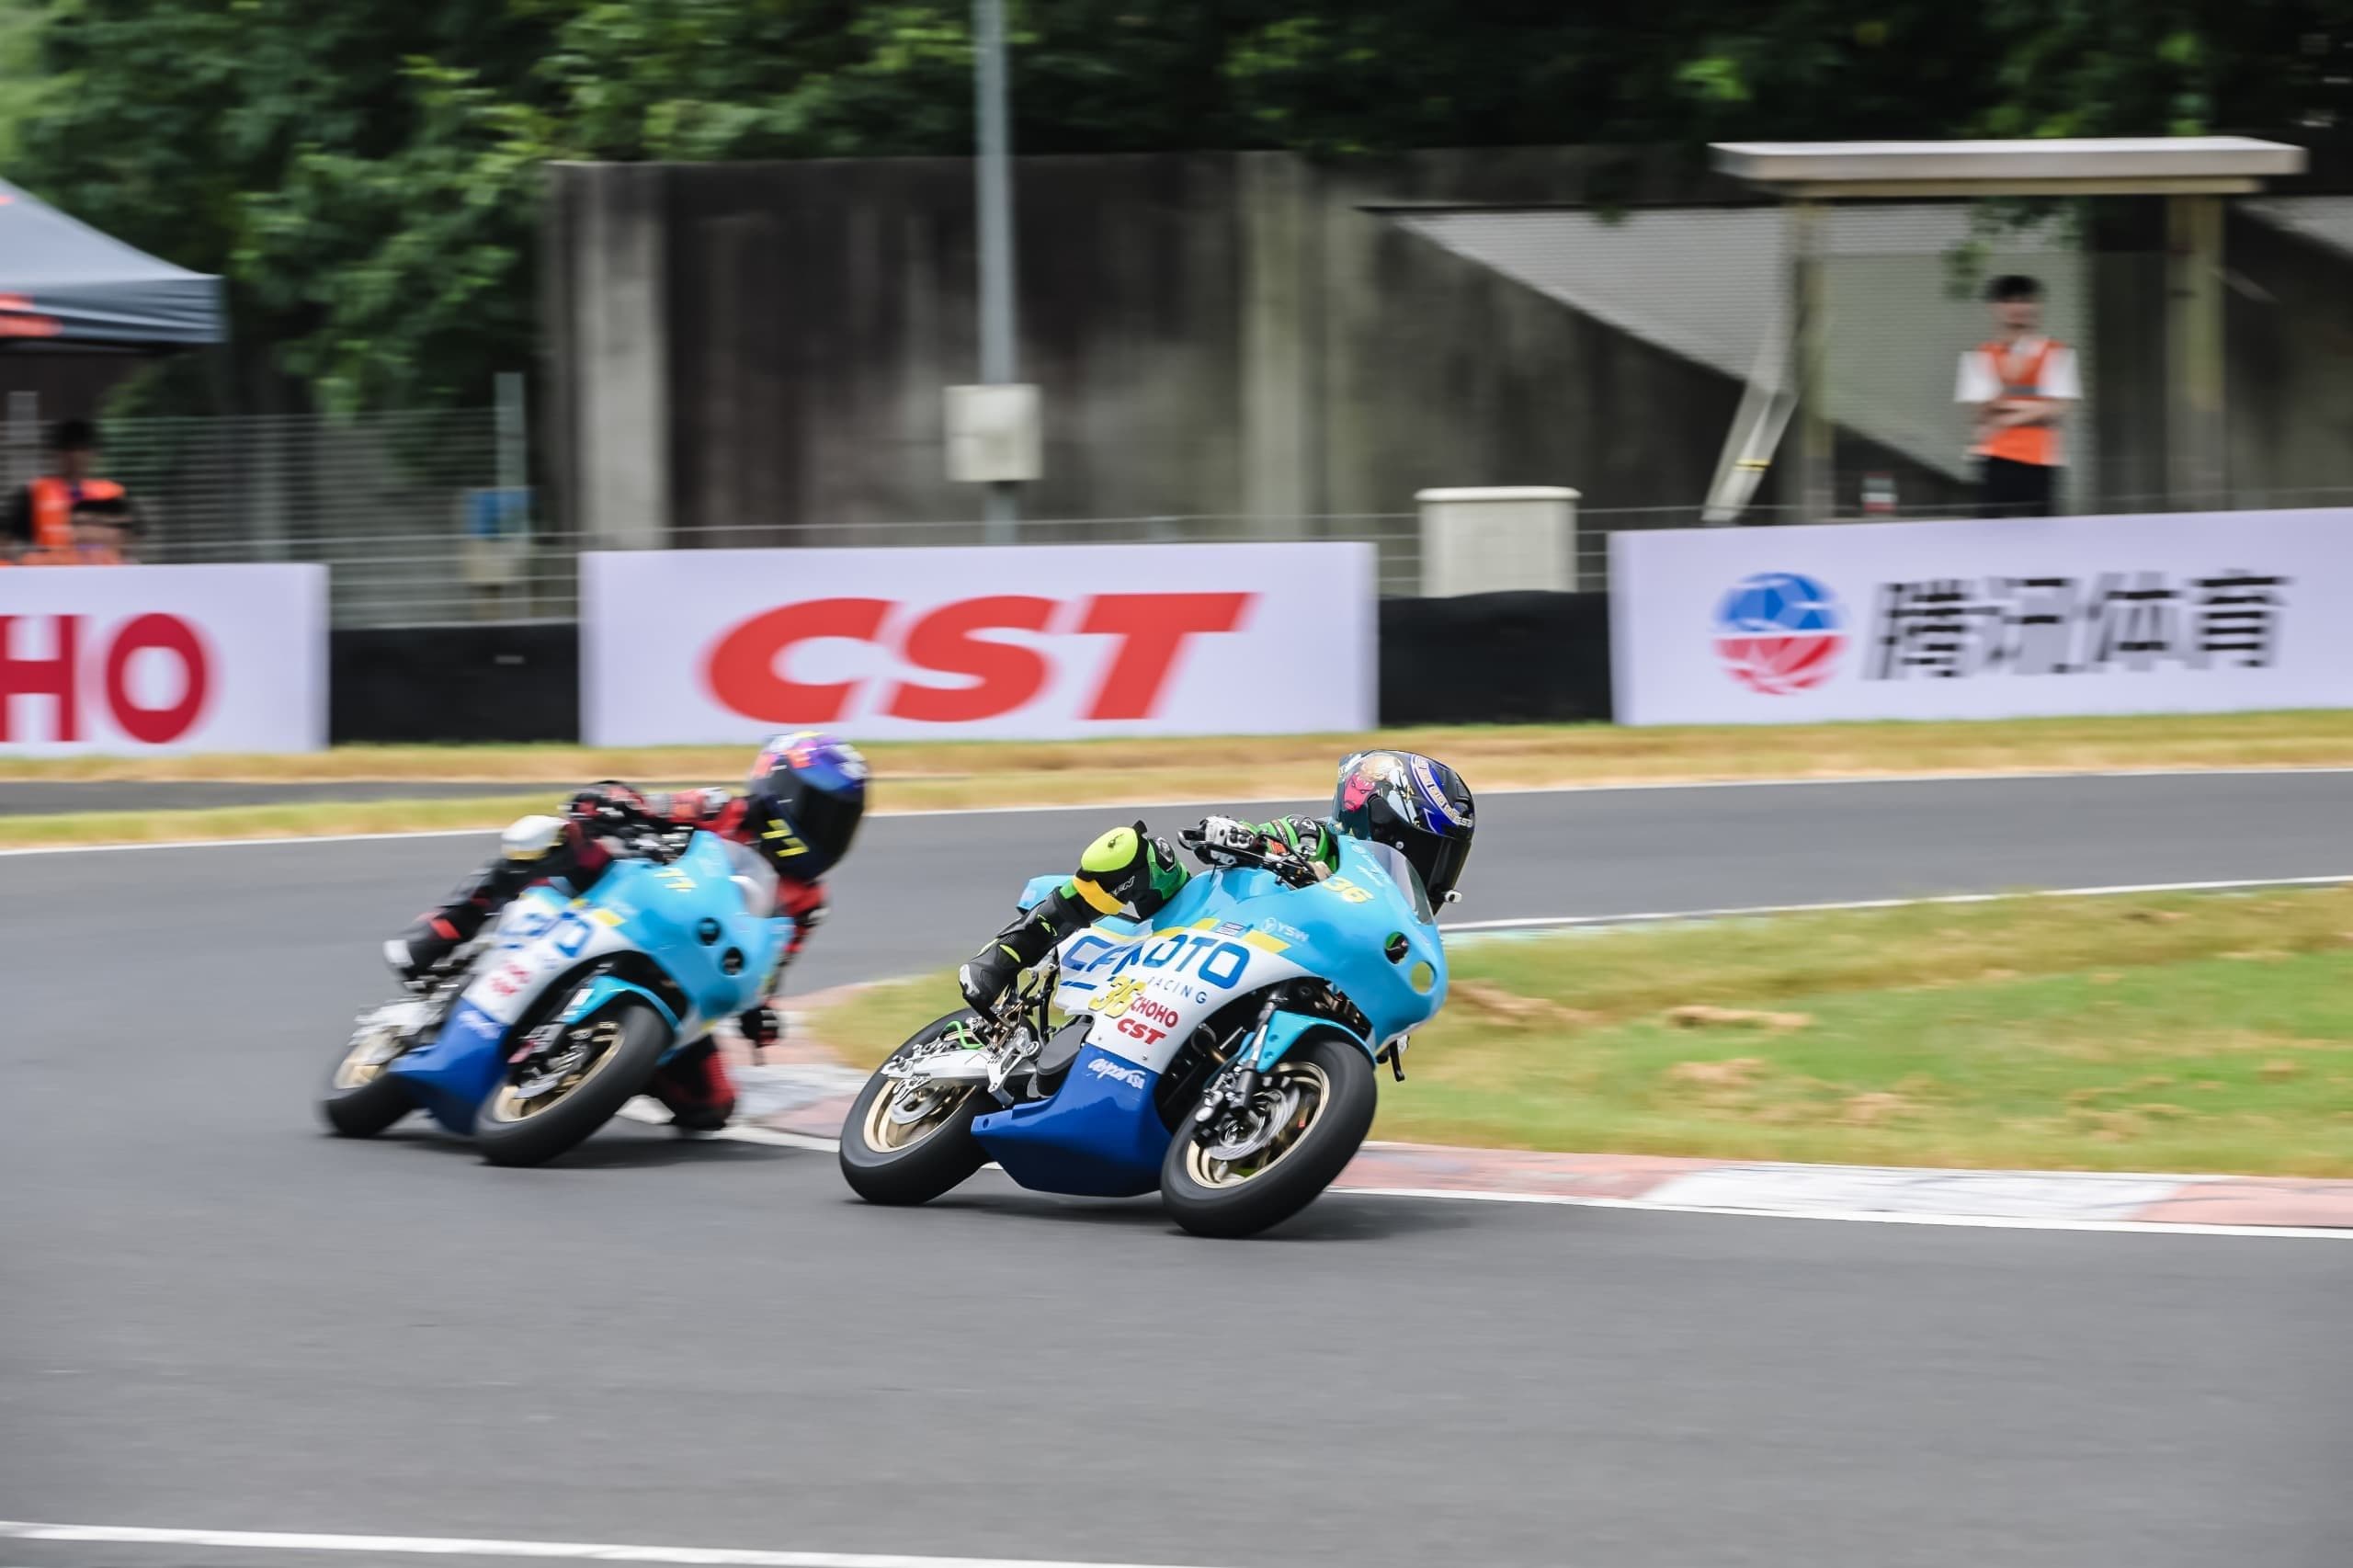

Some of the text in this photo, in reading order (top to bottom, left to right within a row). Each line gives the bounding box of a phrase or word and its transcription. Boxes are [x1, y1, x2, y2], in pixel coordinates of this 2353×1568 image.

[695, 592, 1259, 724] CST
[1321, 876, 1375, 903] 36
[1131, 996, 1178, 1028] CHOHO
[1117, 1018, 1167, 1045] CST
